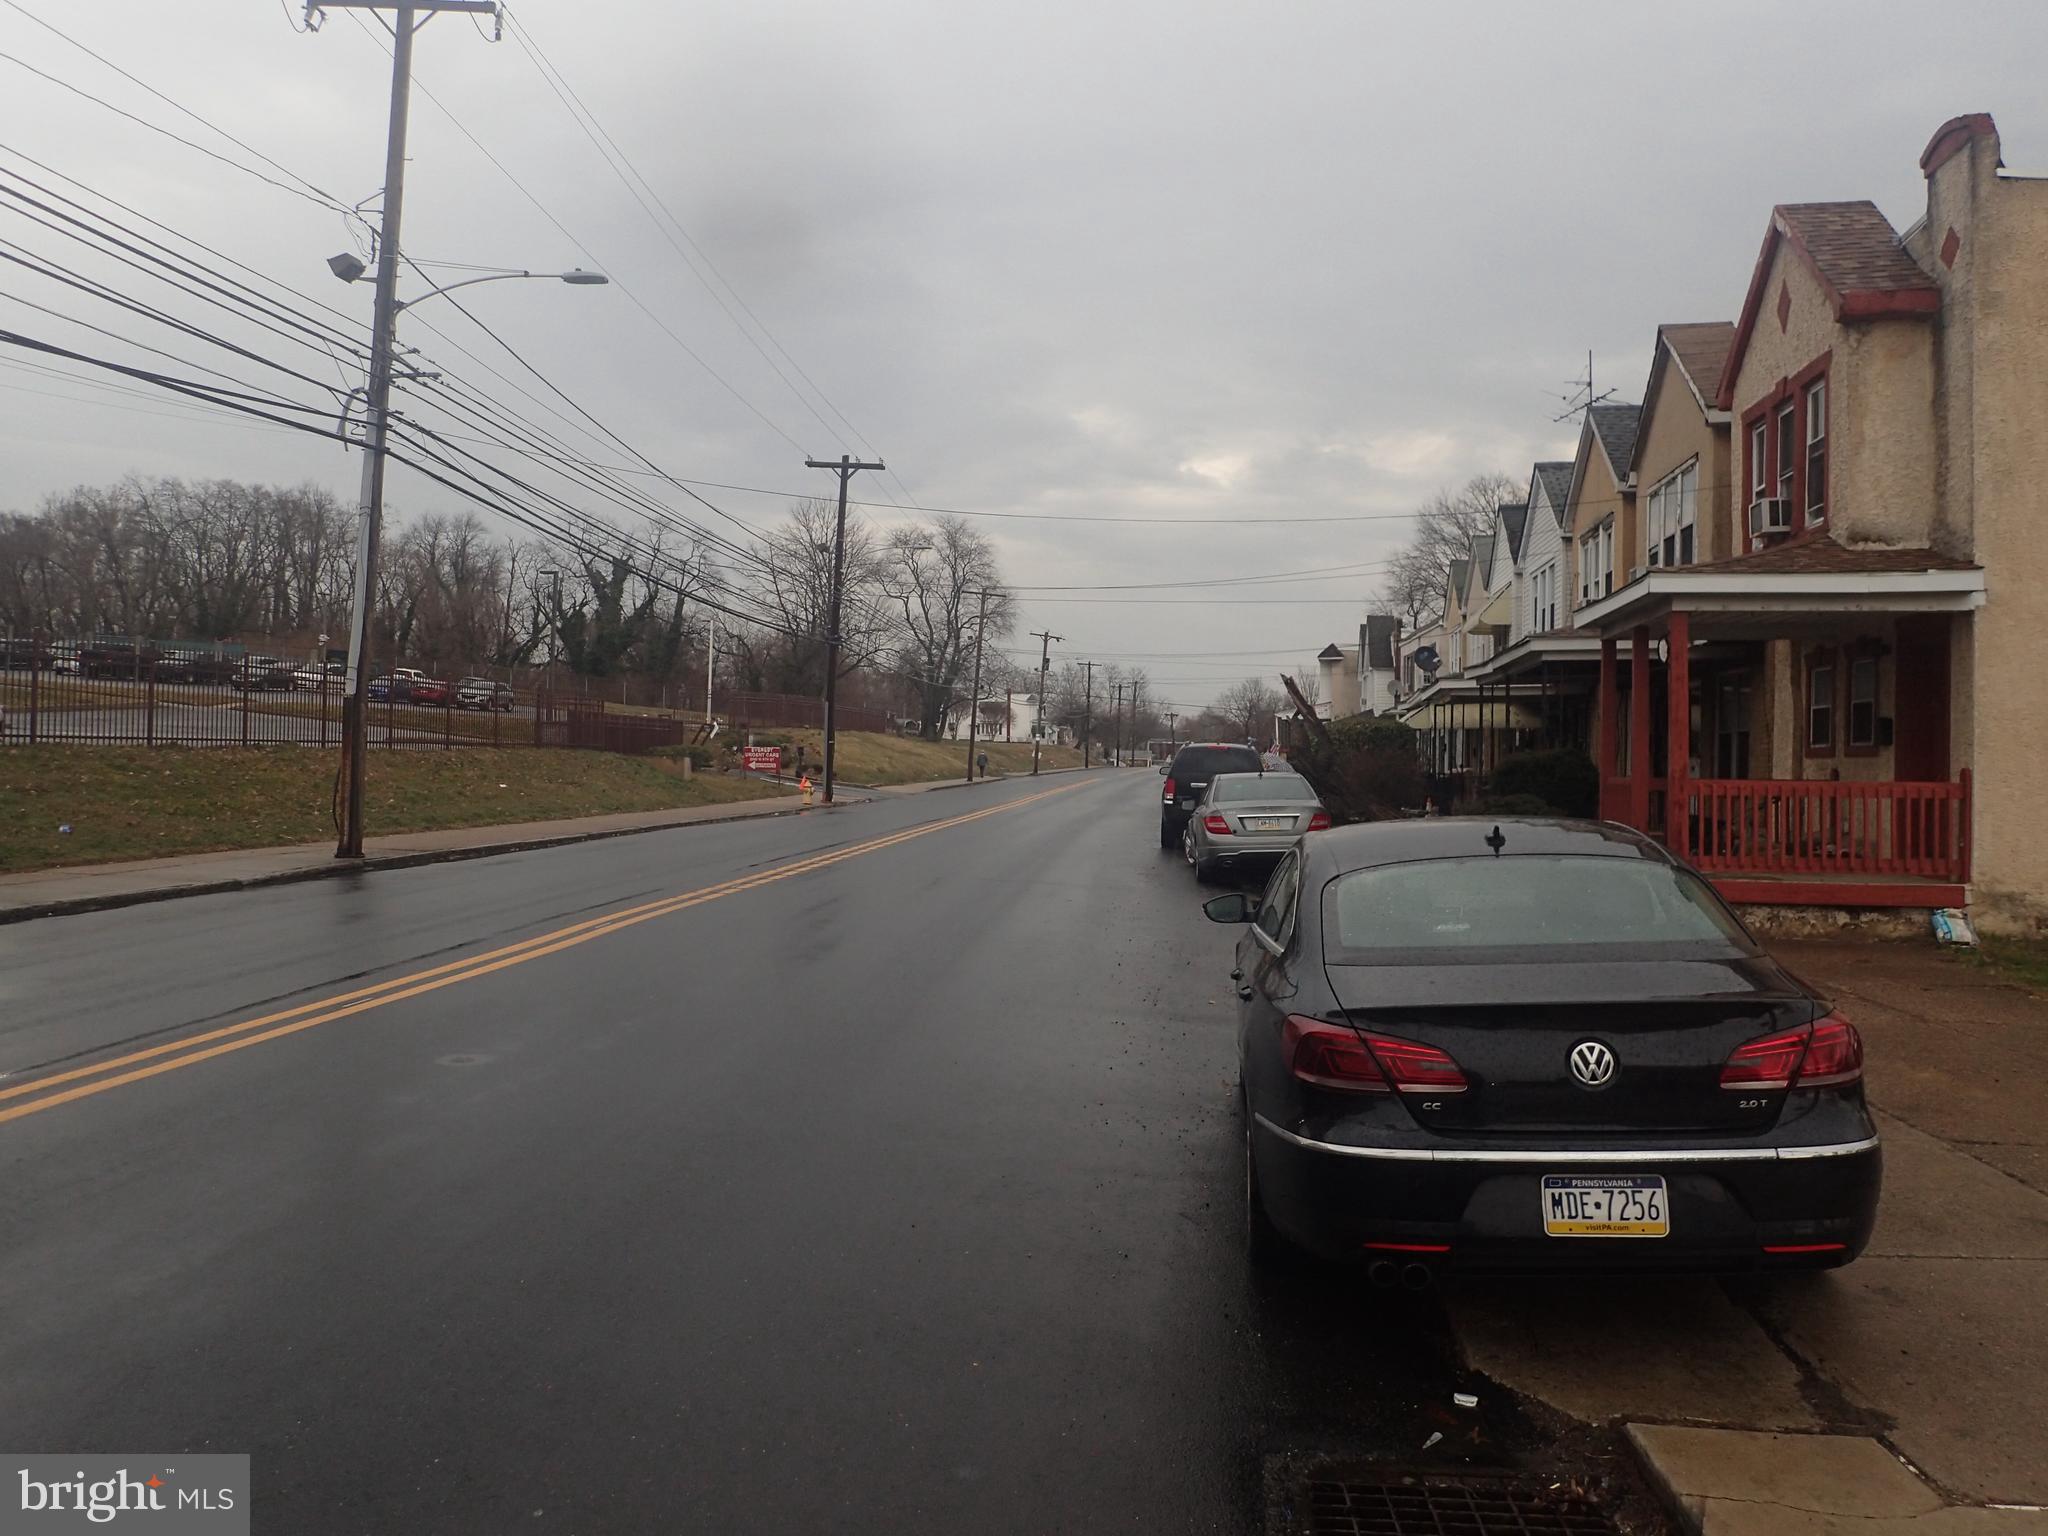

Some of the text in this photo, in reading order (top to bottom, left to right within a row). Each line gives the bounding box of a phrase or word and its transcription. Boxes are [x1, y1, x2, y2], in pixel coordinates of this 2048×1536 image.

[1422, 1102, 1441, 1110] CC
[1571, 1179, 1633, 1188] PENNSYLVANIA
[1586, 1223, 1629, 1232] visitPA.com
